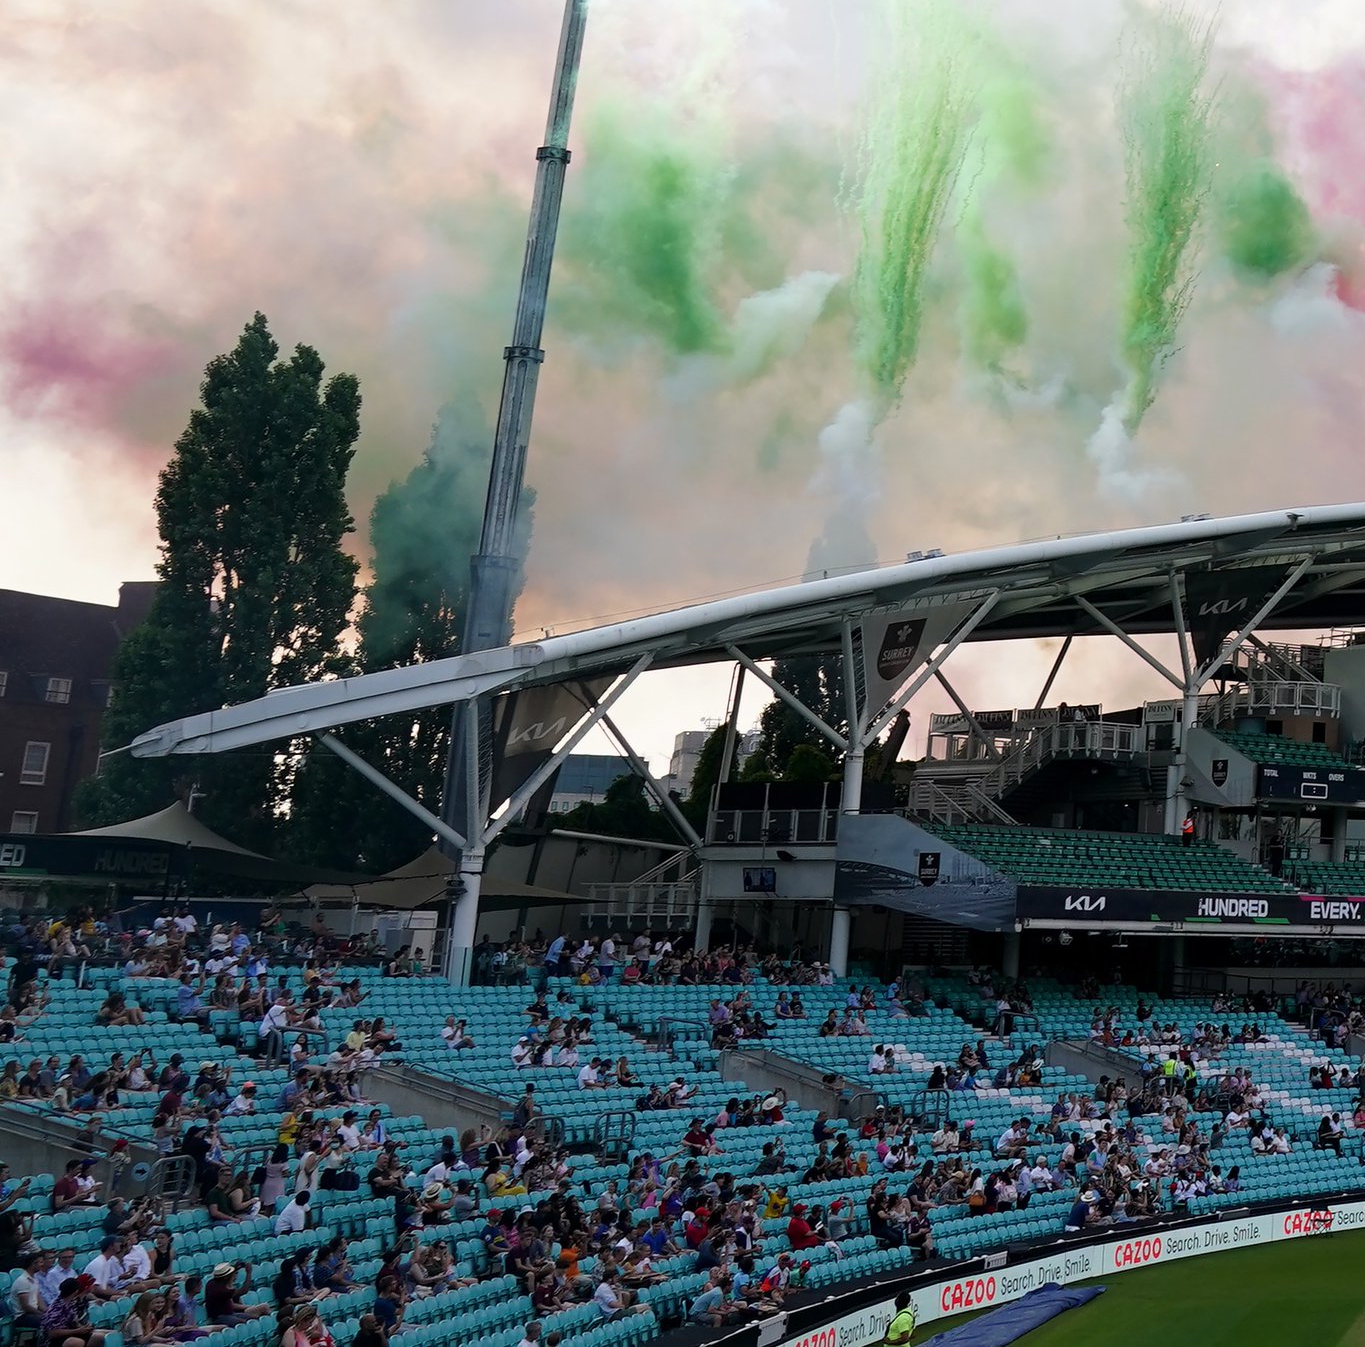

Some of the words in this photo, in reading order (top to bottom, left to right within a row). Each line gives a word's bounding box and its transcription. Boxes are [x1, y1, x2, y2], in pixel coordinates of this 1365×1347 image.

[882, 646, 914, 661] SURREY
[1198, 898, 1268, 918] HUNDRED
[1310, 901, 1361, 919] EVERY.
[1115, 1237, 1162, 1267] CAZOO
[1166, 1233, 1201, 1255] Search.
[1204, 1227, 1230, 1247] Drive.
[1233, 1221, 1261, 1242] Smile.
[941, 1276, 996, 1312] CAZOO
[1001, 1270, 1034, 1295] Search.
[1064, 1254, 1092, 1277] Smile.
[839, 1318, 867, 1347] Search.
